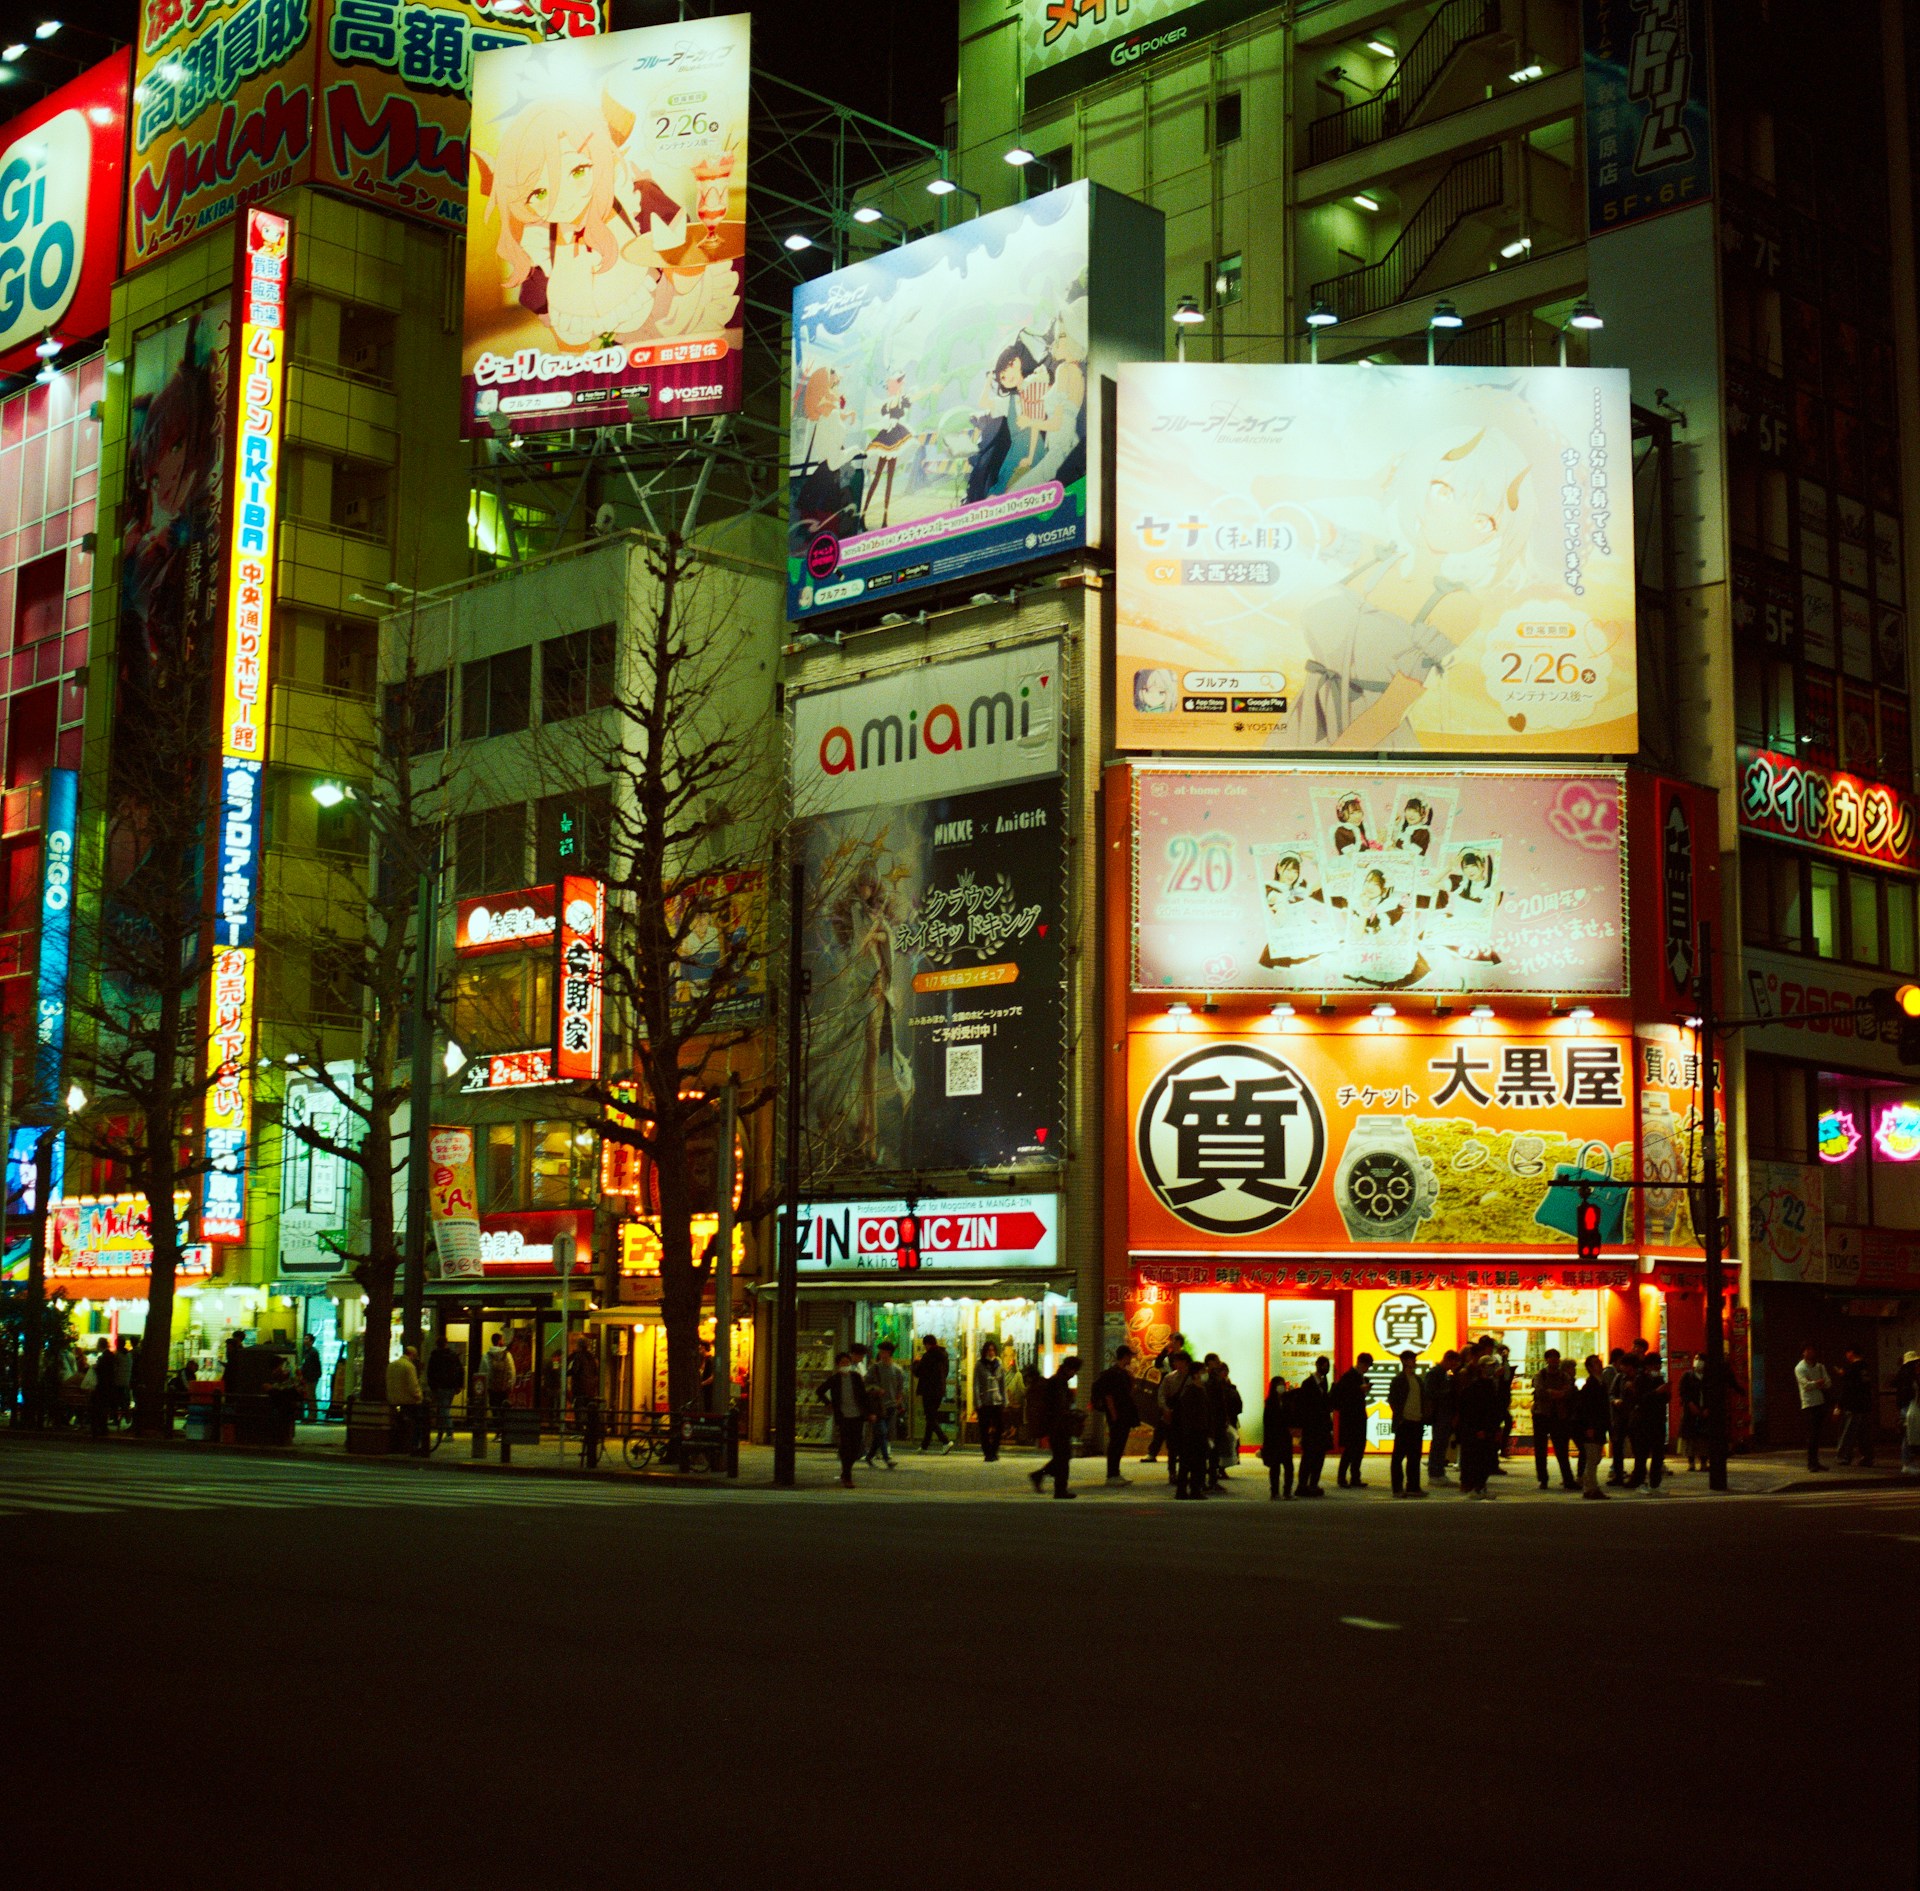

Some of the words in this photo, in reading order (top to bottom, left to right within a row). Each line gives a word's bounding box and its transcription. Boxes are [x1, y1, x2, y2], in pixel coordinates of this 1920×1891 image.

[197, 193, 234, 229] AKIBA
[508, 399, 541, 409] ブルアカ
[674, 385, 722, 400] YOSTAR
[1037, 525, 1077, 544] YOSTAR
[1154, 566, 1175, 579] CV
[1187, 564, 1270, 583] 大西沙織
[1195, 677, 1240, 689] ブルアカ
[819, 686, 1030, 776] amiami
[1247, 723, 1288, 732] YOSTAR
[1744, 763, 1914, 855] メイドカジノ
[934, 819, 973, 846] NIKKE
[995, 808, 1047, 834] AniGift
[46, 831, 72, 910] GiGO
[928, 884, 1004, 919] クラウン
[895, 904, 1042, 952] ネイキッドキング
[1338, 1084, 1419, 1109] チケット
[1429, 1045, 1624, 1110] 大黒屋
[207, 1128, 245, 1149] 2F
[1160, 1074, 1303, 1210] 質
[859, 1217, 951, 1251] COIC
[957, 1216, 998, 1249] ZIN
[1382, 1304, 1428, 1349] 質
